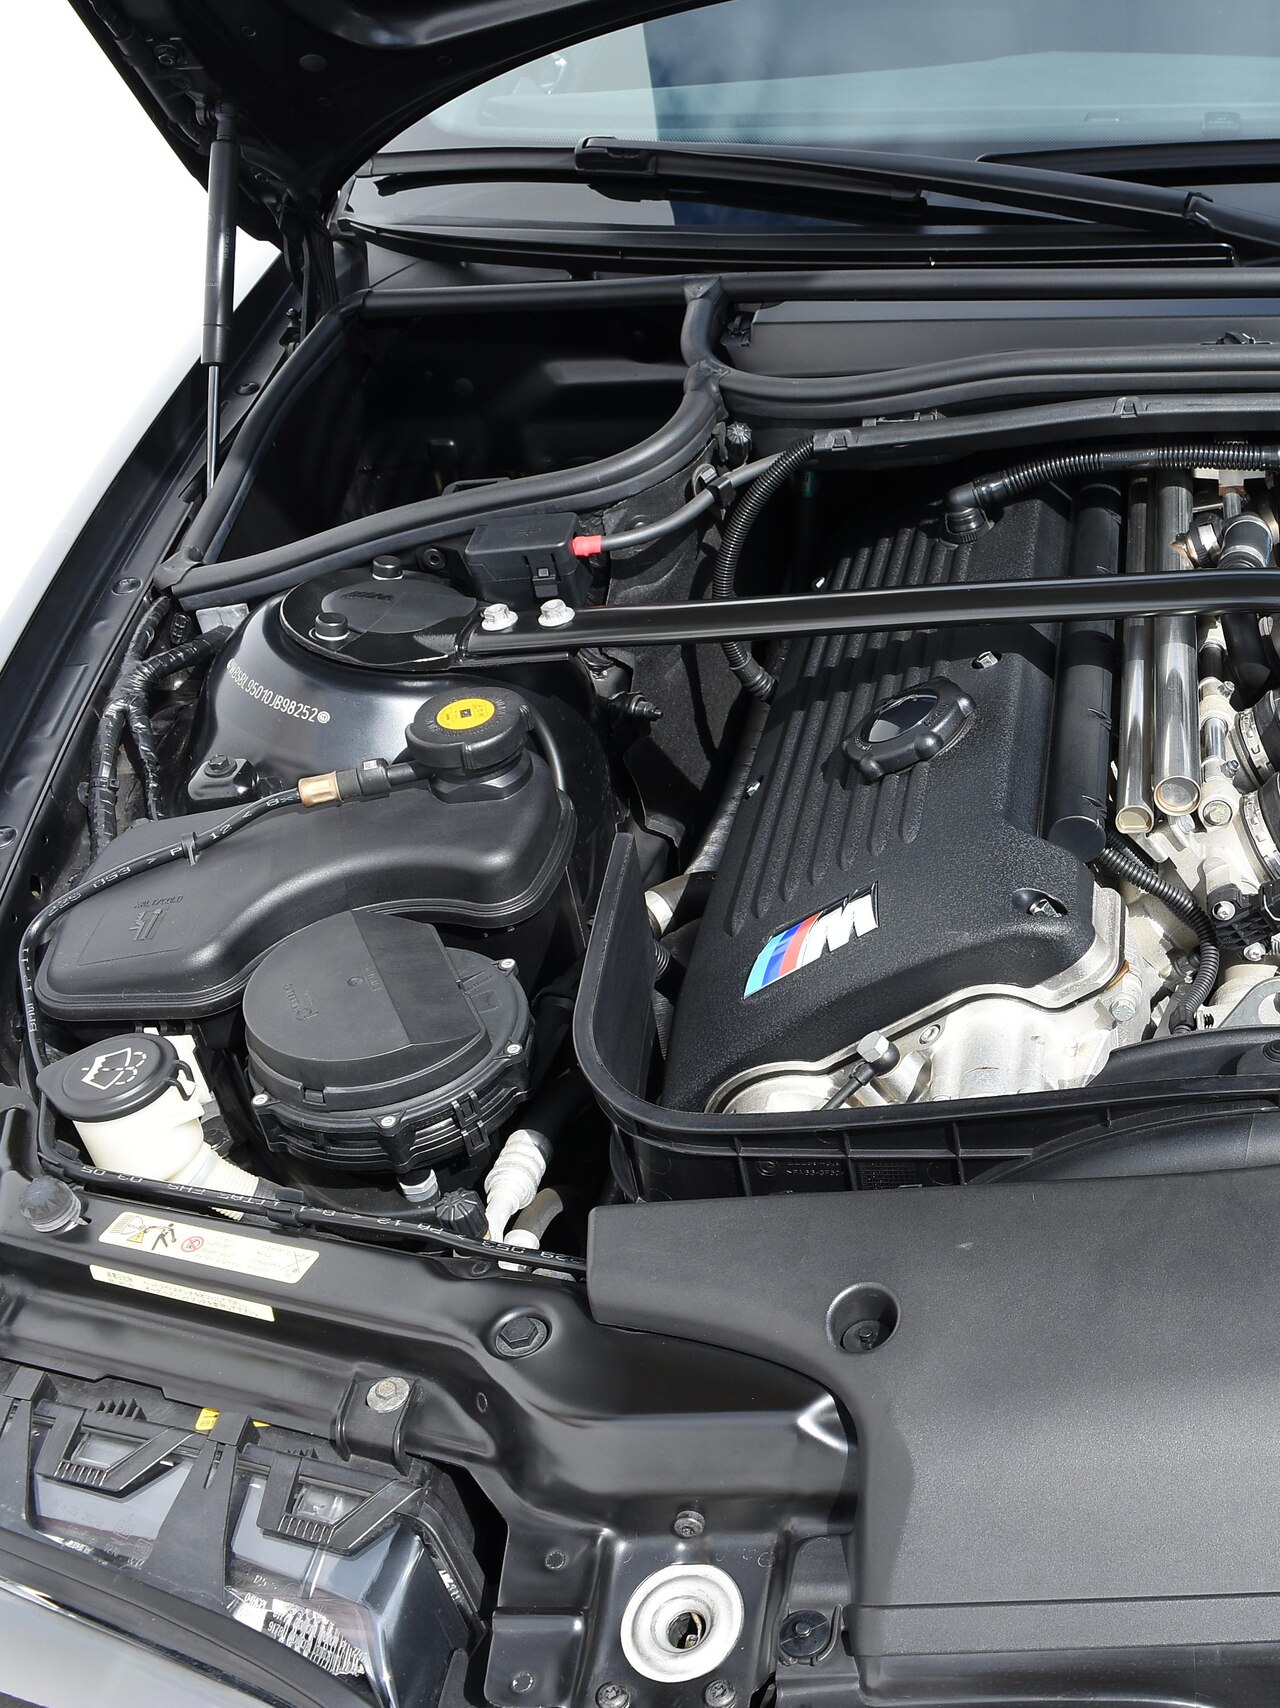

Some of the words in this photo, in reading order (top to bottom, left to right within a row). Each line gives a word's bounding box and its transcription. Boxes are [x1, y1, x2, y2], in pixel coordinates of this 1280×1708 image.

[27, 1002, 38, 1032] BMW
[93, 866, 132, 889] 053
[210, 823, 233, 840] 12
[377, 1217, 402, 1227] 12
